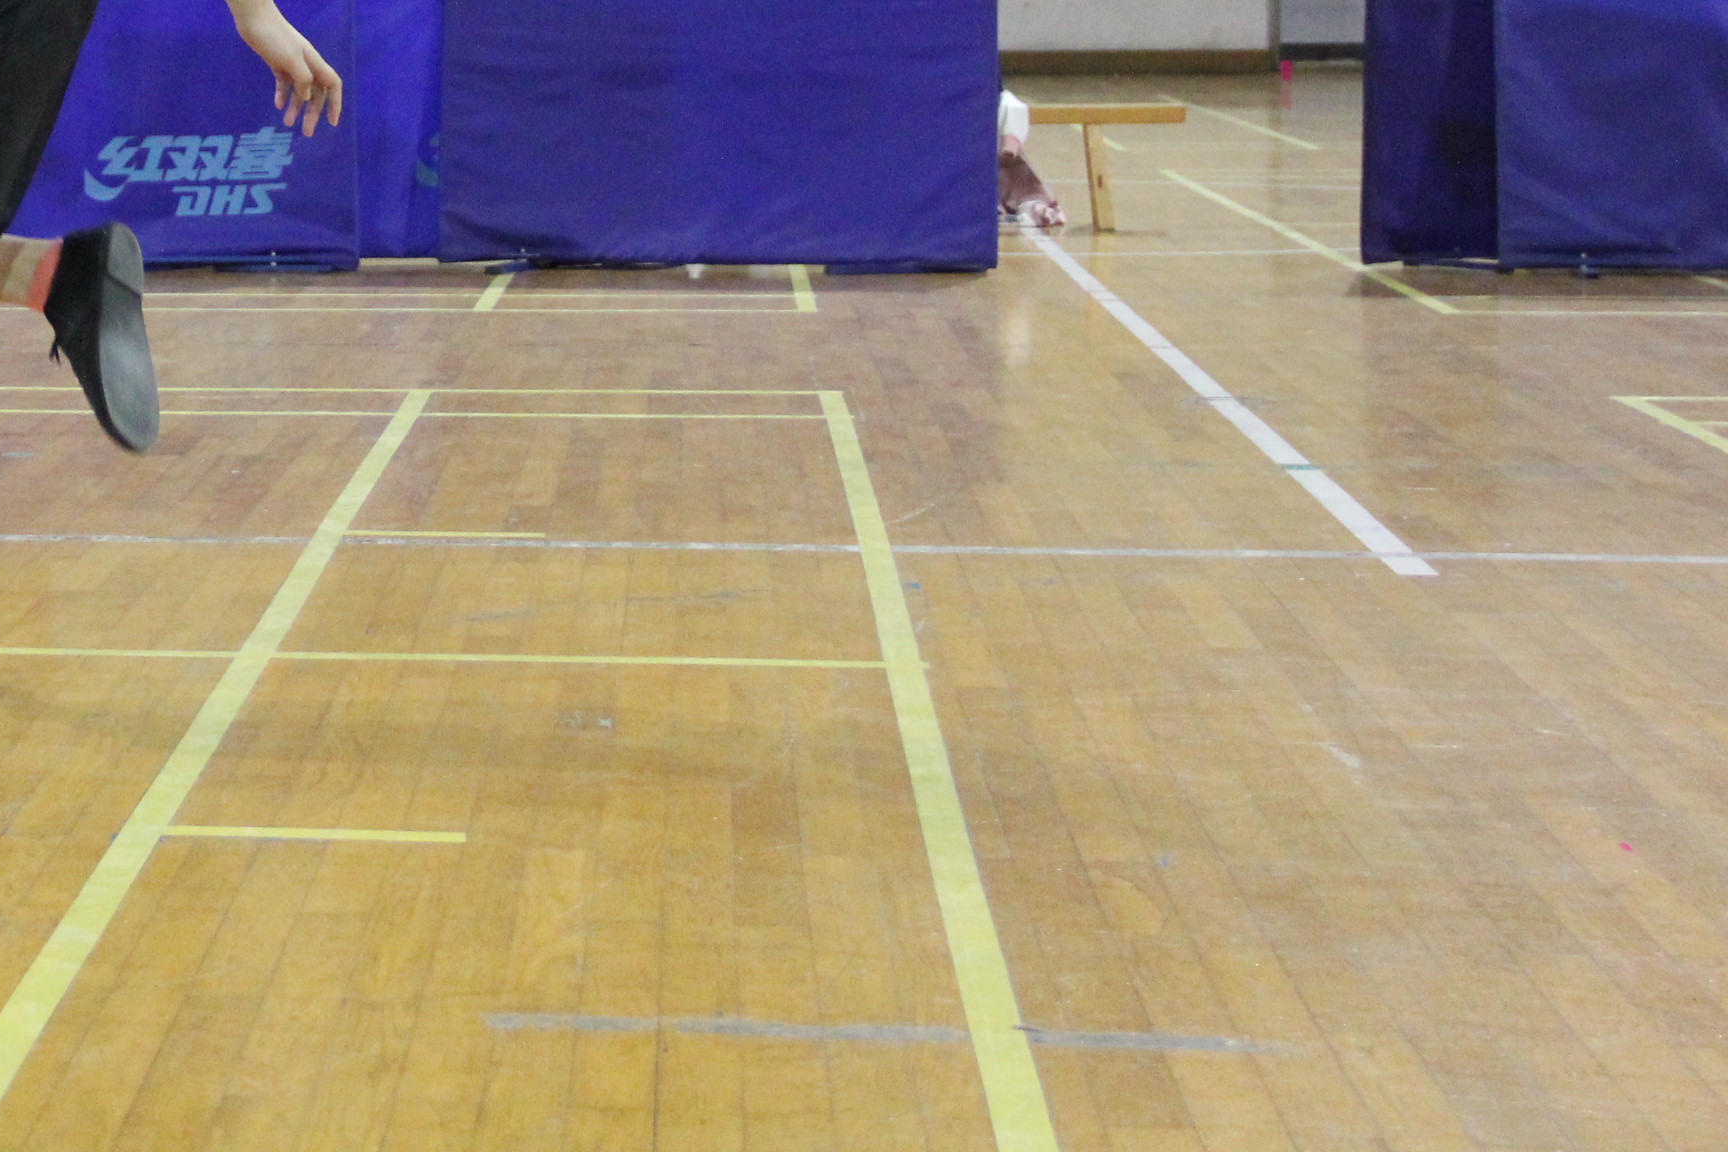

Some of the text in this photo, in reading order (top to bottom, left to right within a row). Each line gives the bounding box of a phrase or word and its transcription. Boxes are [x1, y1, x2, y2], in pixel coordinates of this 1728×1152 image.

[96, 126, 294, 182] 红双喜
[172, 182, 288, 217] DHS
